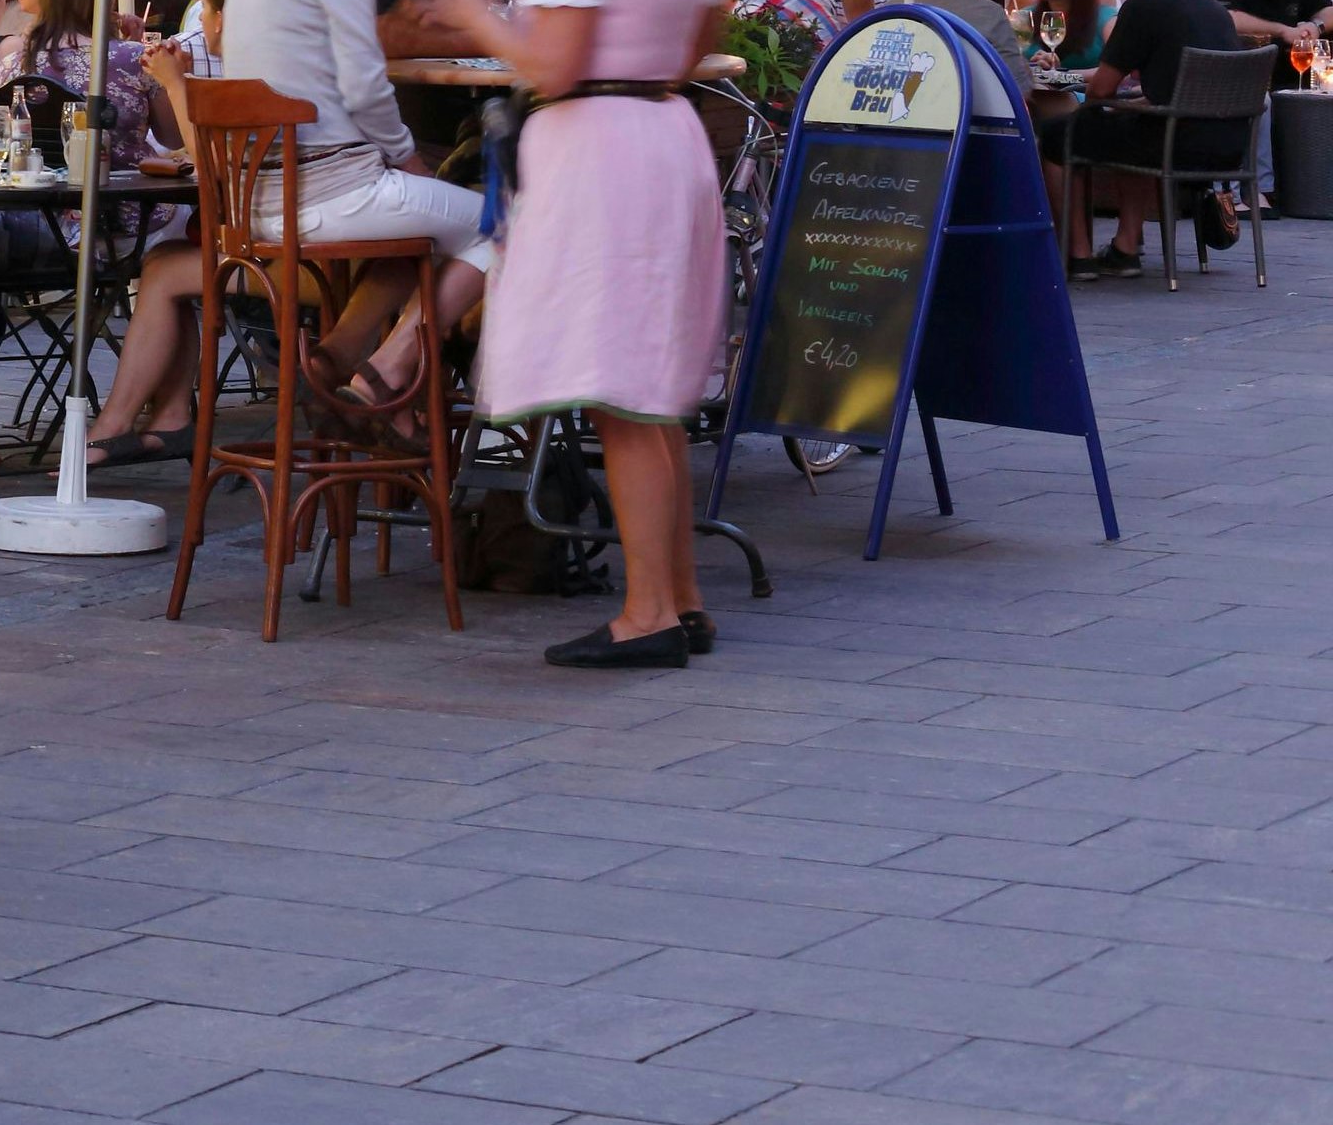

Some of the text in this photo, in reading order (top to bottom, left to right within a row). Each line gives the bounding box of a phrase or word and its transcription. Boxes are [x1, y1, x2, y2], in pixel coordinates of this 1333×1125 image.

[853, 64, 908, 91] Glöckl
[850, 88, 893, 114] Bräu
[809, 161, 921, 192] GEBACKENE
[809, 255, 910, 283] MIT SCHLAG
[829, 280, 860, 293] UND
[803, 337, 858, 371] €4,20
